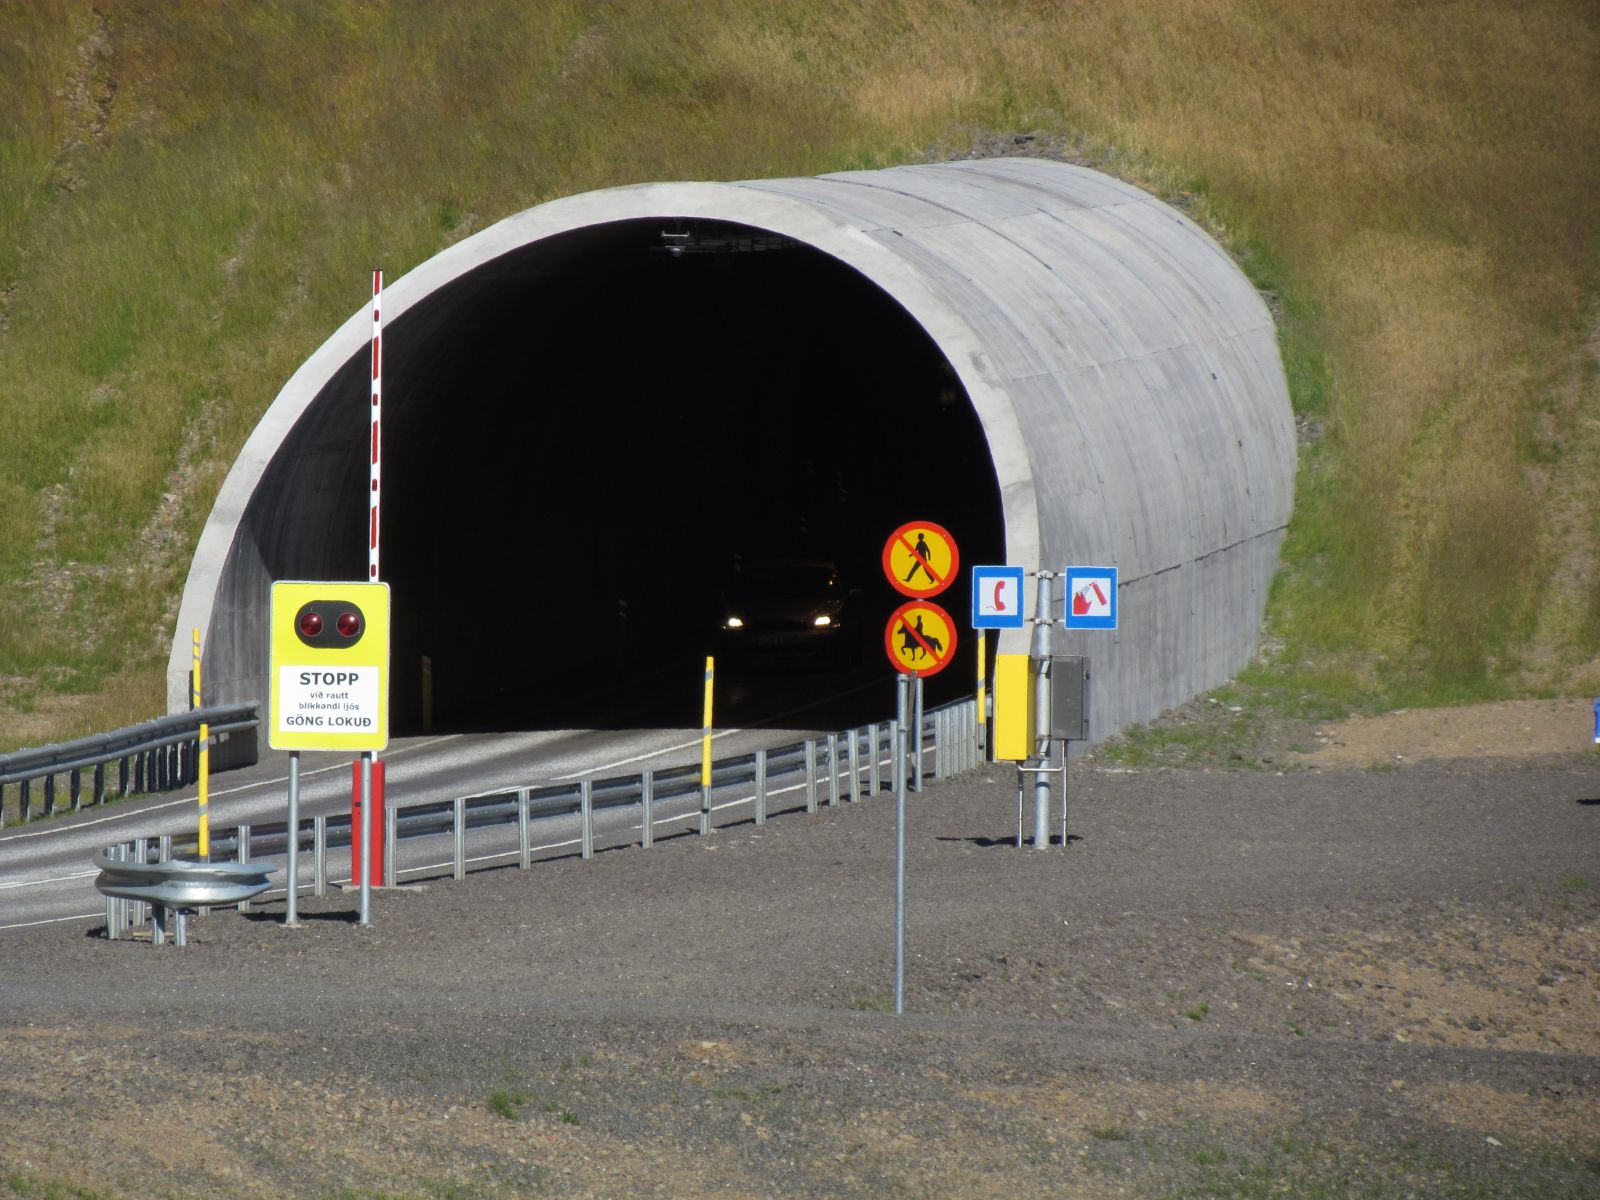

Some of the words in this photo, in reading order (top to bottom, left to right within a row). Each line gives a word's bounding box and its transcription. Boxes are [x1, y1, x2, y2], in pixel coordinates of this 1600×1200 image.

[299, 672, 359, 686] STOPP
[310, 691, 323, 699] við
[299, 702, 341, 710] blikkandi
[343, 703, 360, 712] ljós
[286, 713, 323, 726] GÖNG
[328, 716, 372, 727] LOKUÐ
